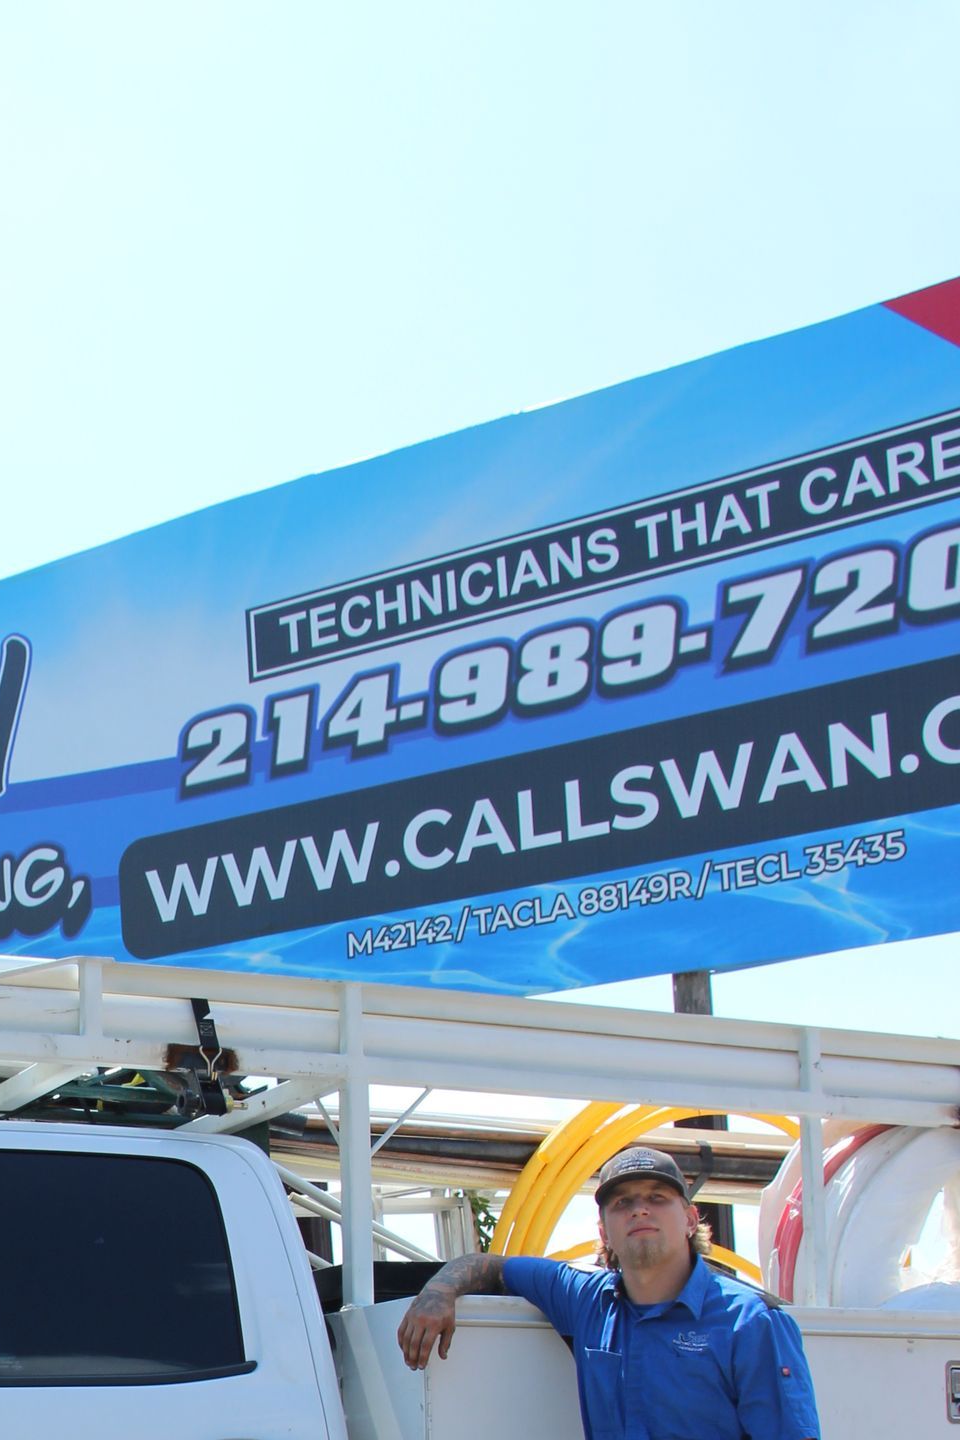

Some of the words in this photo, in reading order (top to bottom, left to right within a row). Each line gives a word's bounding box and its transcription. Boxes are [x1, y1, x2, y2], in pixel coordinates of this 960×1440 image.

[279, 528, 620, 653] TECHNICIANS
[634, 480, 780, 560] THAT
[799, 428, 960, 515] CARE
[347, 914, 453, 958] M42142
[472, 893, 576, 935] TACLA
[578, 870, 692, 916] 88149R
[714, 852, 801, 892] TECL
[803, 829, 906, 875] 35435
